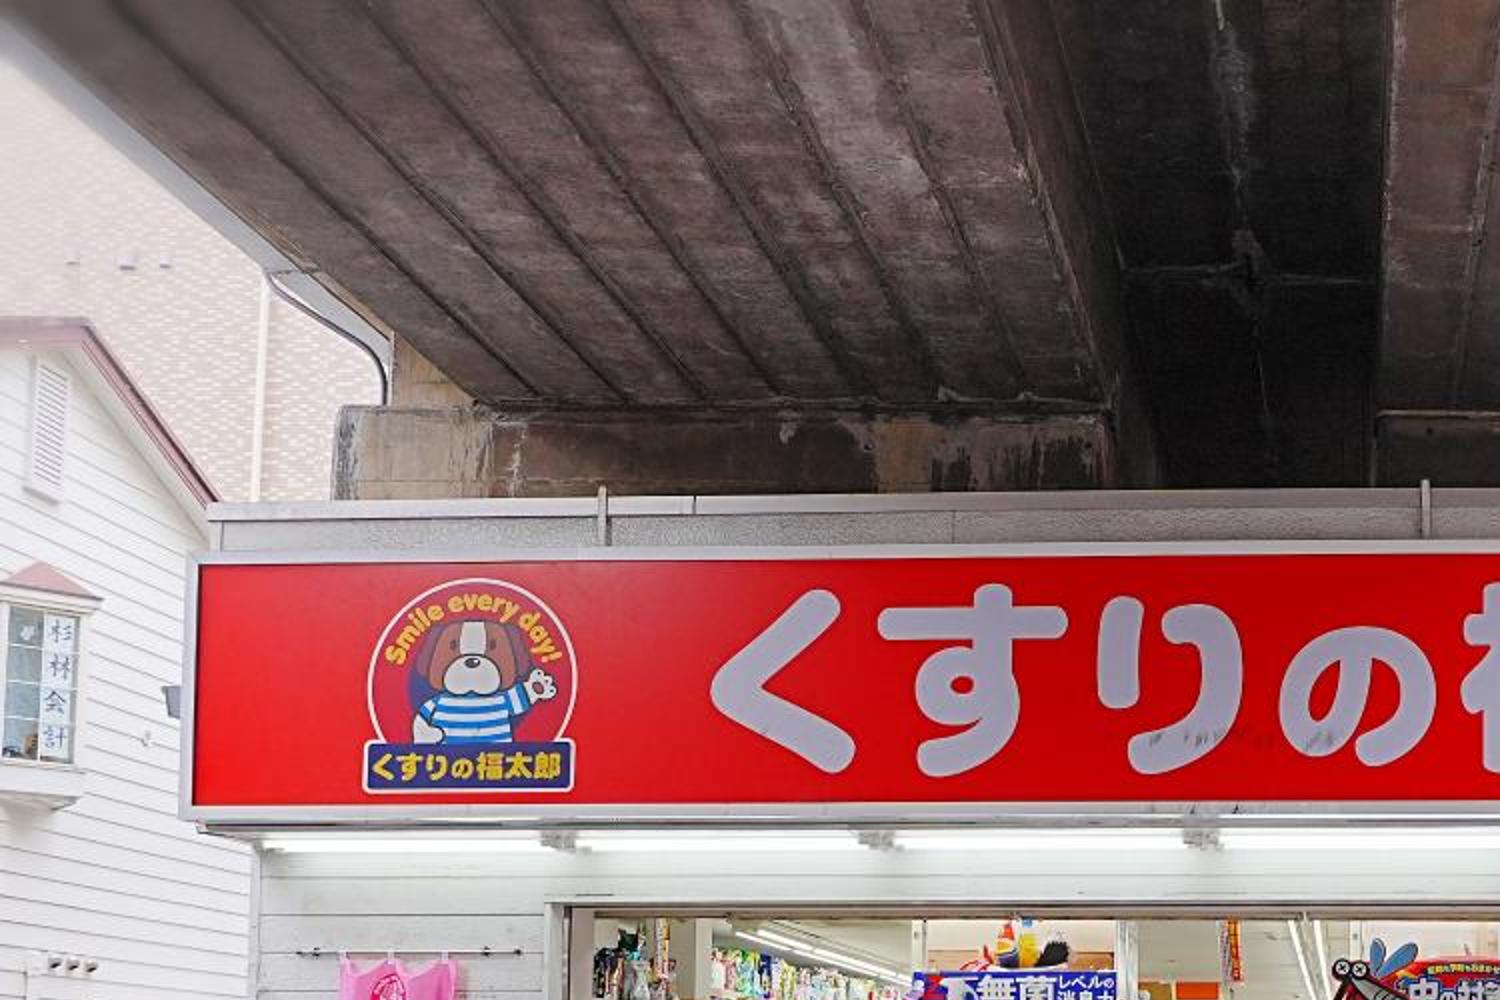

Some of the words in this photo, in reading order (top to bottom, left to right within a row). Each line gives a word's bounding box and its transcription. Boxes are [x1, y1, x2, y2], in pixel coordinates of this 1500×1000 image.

[385, 605, 446, 665] Smile
[447, 593, 521, 622] every
[520, 612, 563, 663] day!
[43, 619, 72, 749] 杉林会計
[371, 752, 562, 781] くすりの福太郎
[1059, 975, 1114, 989] レベルの
